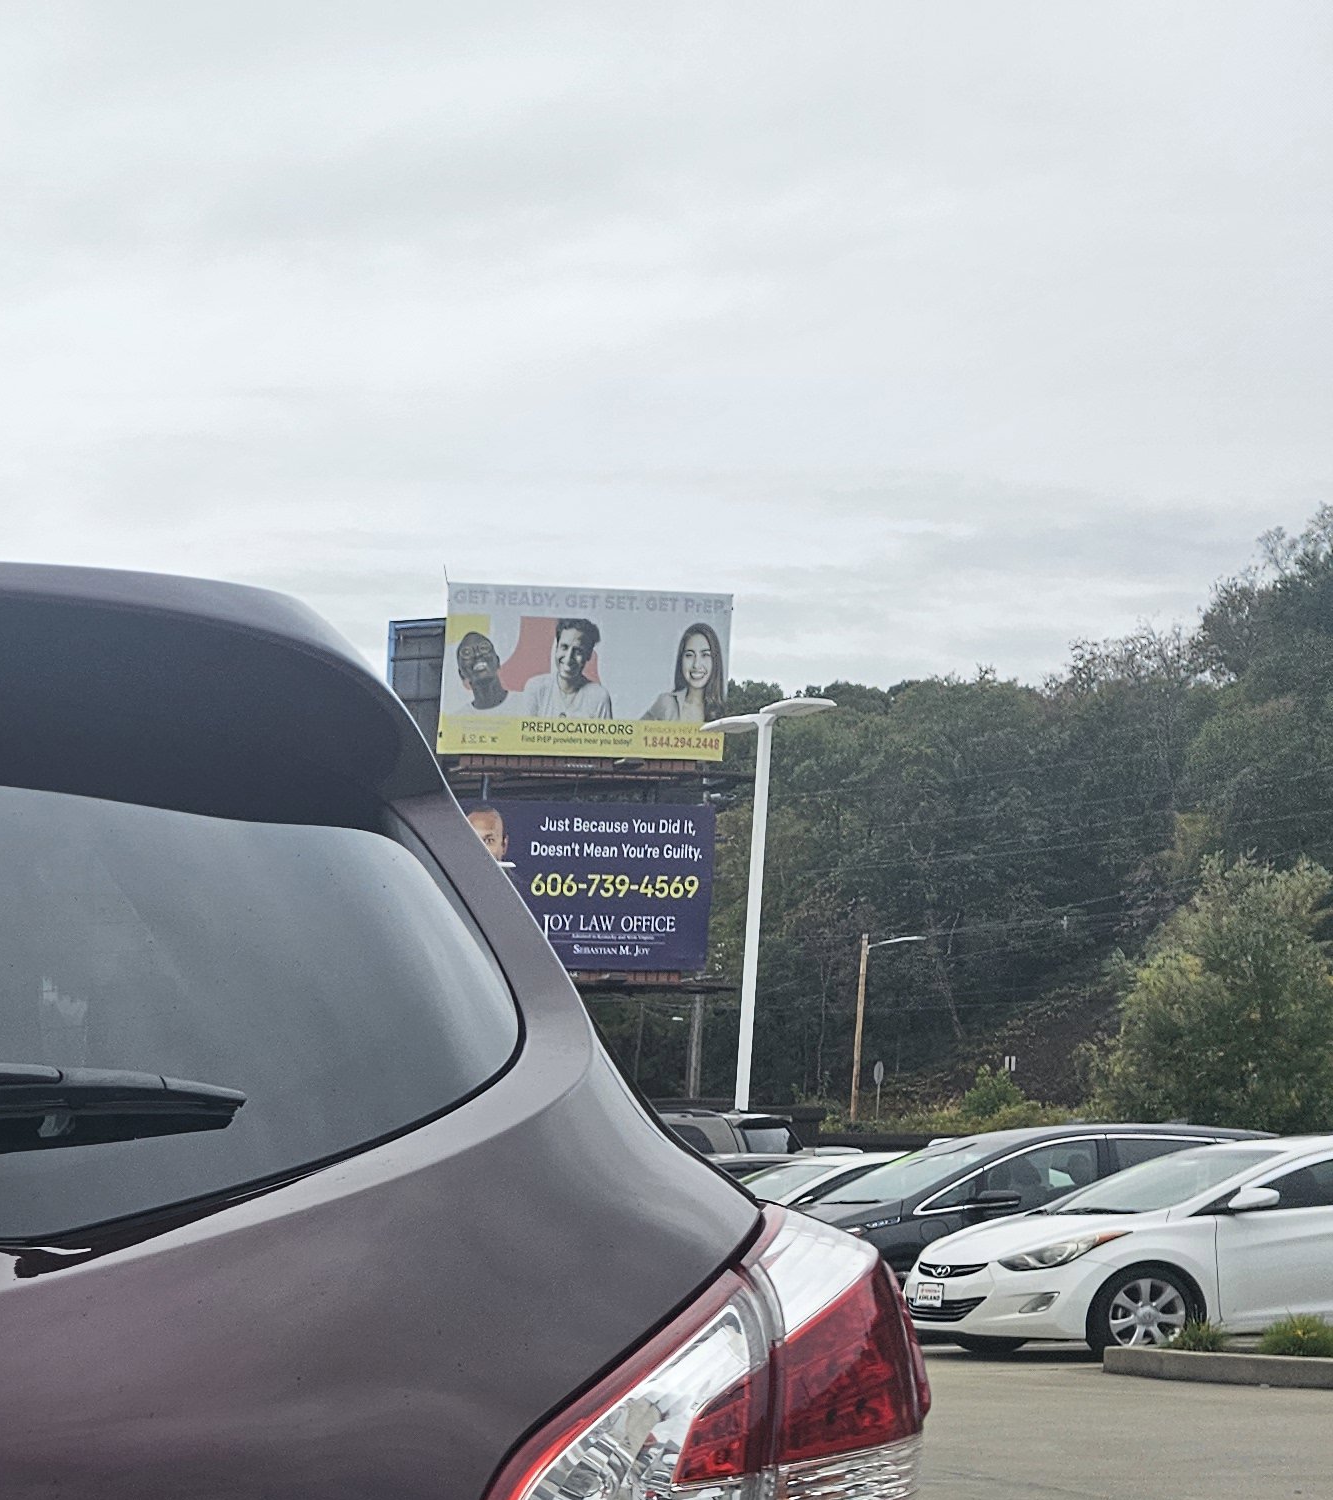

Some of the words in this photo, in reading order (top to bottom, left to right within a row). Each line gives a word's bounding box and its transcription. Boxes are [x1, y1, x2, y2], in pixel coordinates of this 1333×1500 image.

[453, 589, 489, 603] GET
[495, 591, 559, 608] READY.
[565, 593, 598, 609] GET
[605, 595, 639, 611] SET.
[645, 596, 679, 612] GET
[521, 721, 634, 735] PREPLOCATOR.ORG
[521, 734, 535, 743] Find
[553, 736, 583, 745] providers
[600, 738, 612, 747] you
[643, 735, 720, 750] 1.844.294.2448
[540, 816, 570, 832] Just
[573, 818, 629, 834] Because
[632, 818, 656, 834] You
[659, 818, 680, 834] Did
[684, 819, 696, 837] It,
[530, 841, 580, 857] Doesn't
[583, 842, 618, 858] Mean
[621, 843, 660, 859] You're
[663, 844, 703, 862] Guilty.
[530, 872, 700, 899] 606-739-4569
[543, 913, 574, 939] JOY
[579, 914, 615, 932] LAW
[620, 915, 676, 933] OFFICE
[619, 945, 632, 956] M.
